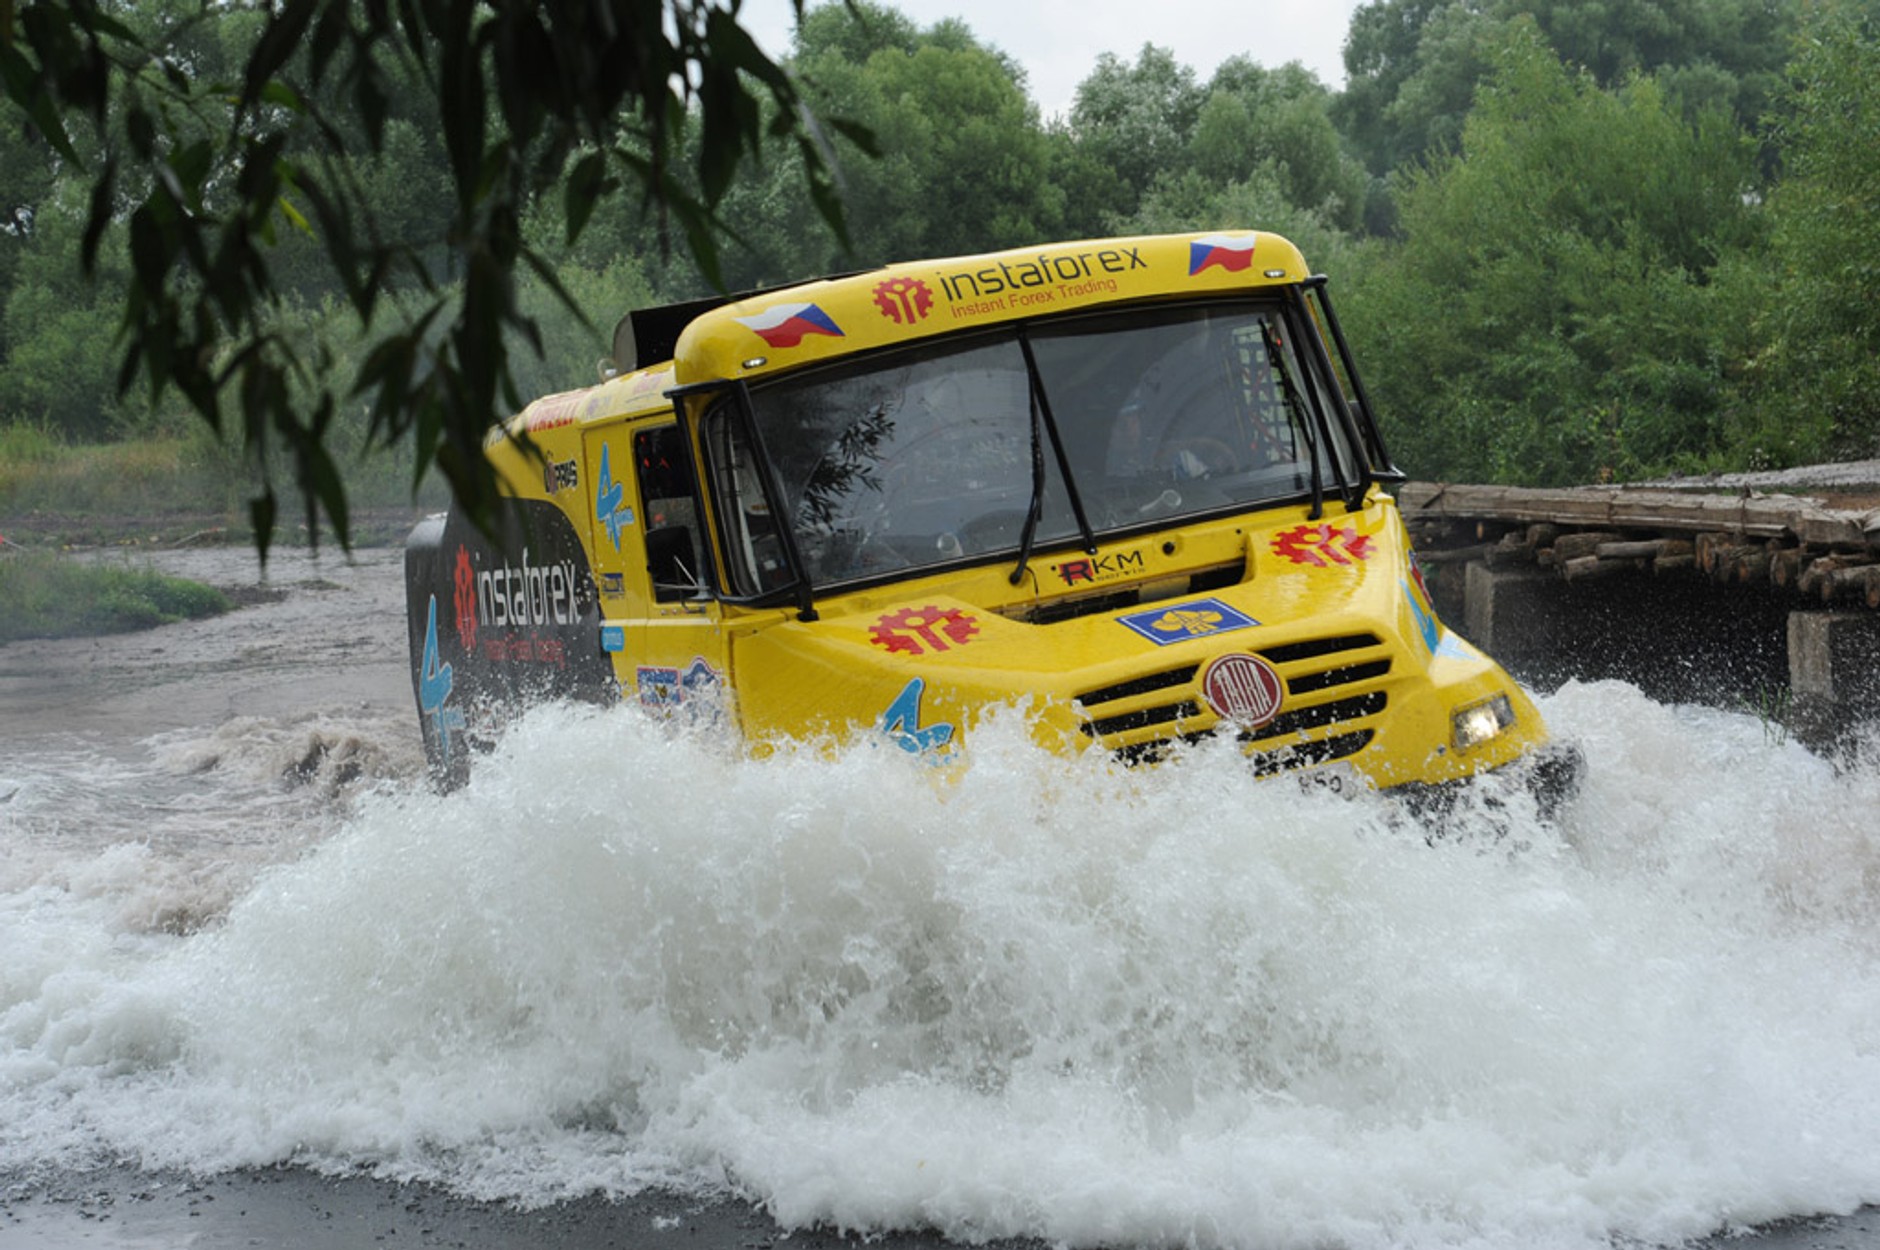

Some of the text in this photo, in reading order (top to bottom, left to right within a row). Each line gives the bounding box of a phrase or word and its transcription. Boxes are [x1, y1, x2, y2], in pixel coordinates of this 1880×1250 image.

[936, 248, 1147, 301] instaforex
[951, 278, 1118, 318] Instant Forex Trading
[475, 547, 582, 626] instaforex
[1059, 551, 1144, 586] RKM
[1213, 660, 1272, 718] TATRA
